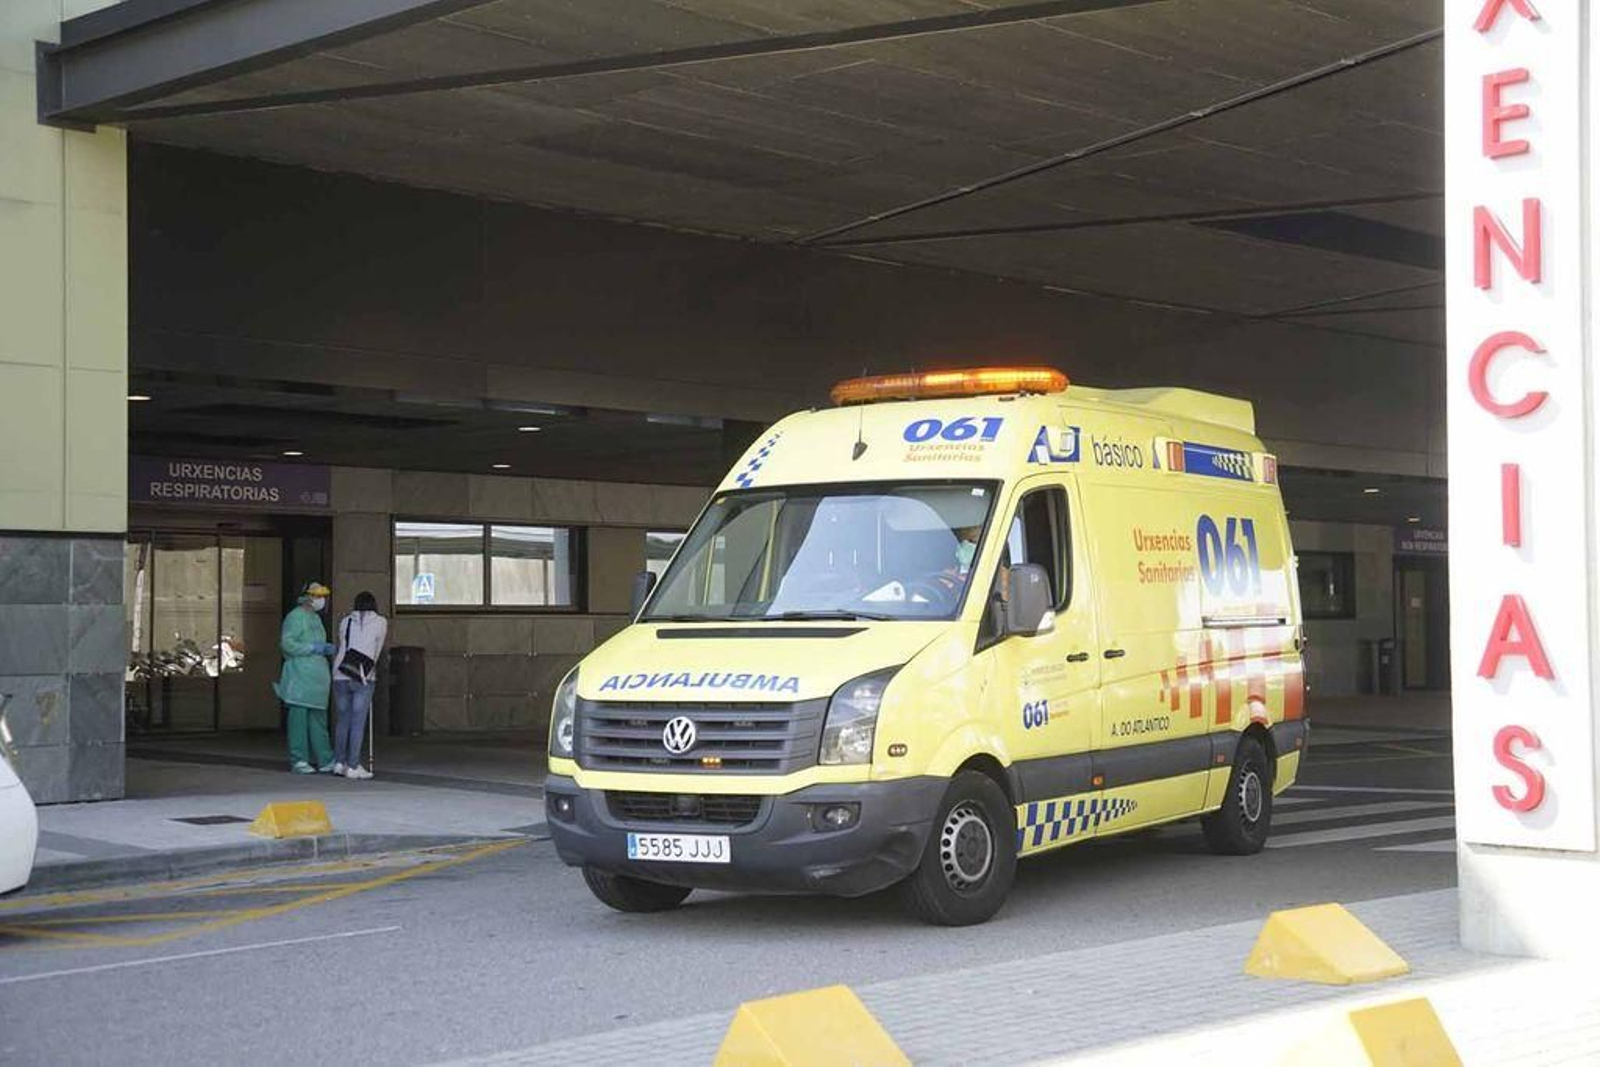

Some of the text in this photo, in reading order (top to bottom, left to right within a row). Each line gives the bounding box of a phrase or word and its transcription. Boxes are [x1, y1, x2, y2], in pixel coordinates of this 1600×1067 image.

[903, 416, 1003, 443] 061
[902, 452, 983, 463] Sanitarias
[1092, 436, 1144, 469] básico
[169, 462, 263, 482] URXENCIAS
[150, 482, 280, 503] RESPIRATORIAS
[1133, 529, 1192, 552] Urxencias
[1196, 514, 1261, 596] 061
[1138, 560, 1196, 585] Sanitarias
[1023, 699, 1049, 730] 061
[1121, 720, 1132, 736] DO
[639, 837, 724, 859] 5585 JJJ
